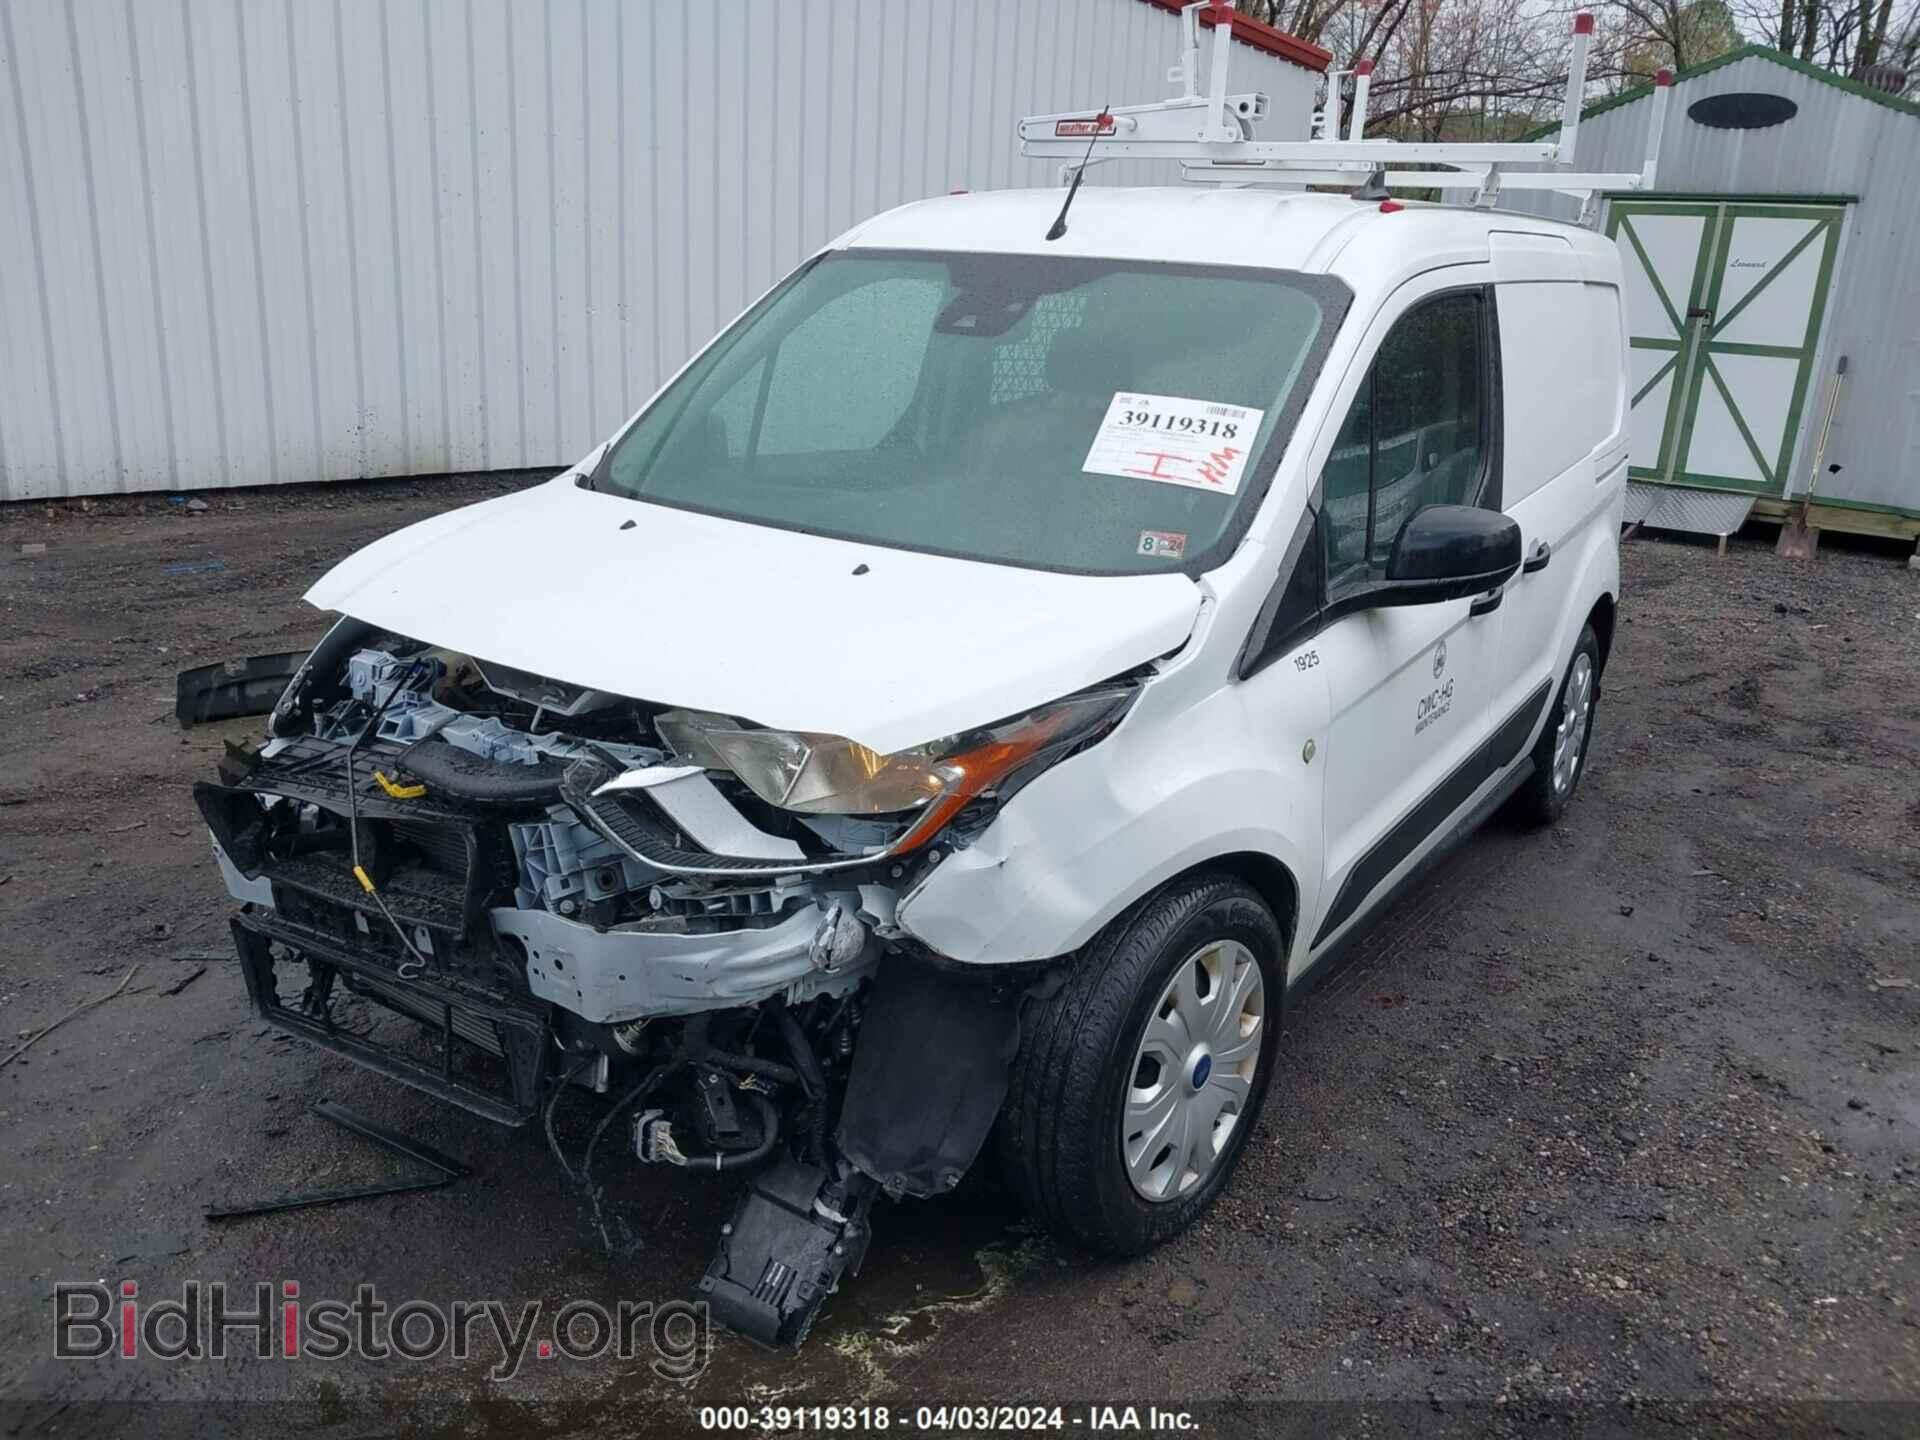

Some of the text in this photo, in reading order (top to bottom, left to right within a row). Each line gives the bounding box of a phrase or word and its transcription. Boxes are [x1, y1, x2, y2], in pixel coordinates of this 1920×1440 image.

[1119, 410, 1239, 440] 39119318
[1142, 536, 1155, 551] 8
[1294, 650, 1320, 673] 1925
[1416, 678, 1454, 720] CWC-HG
